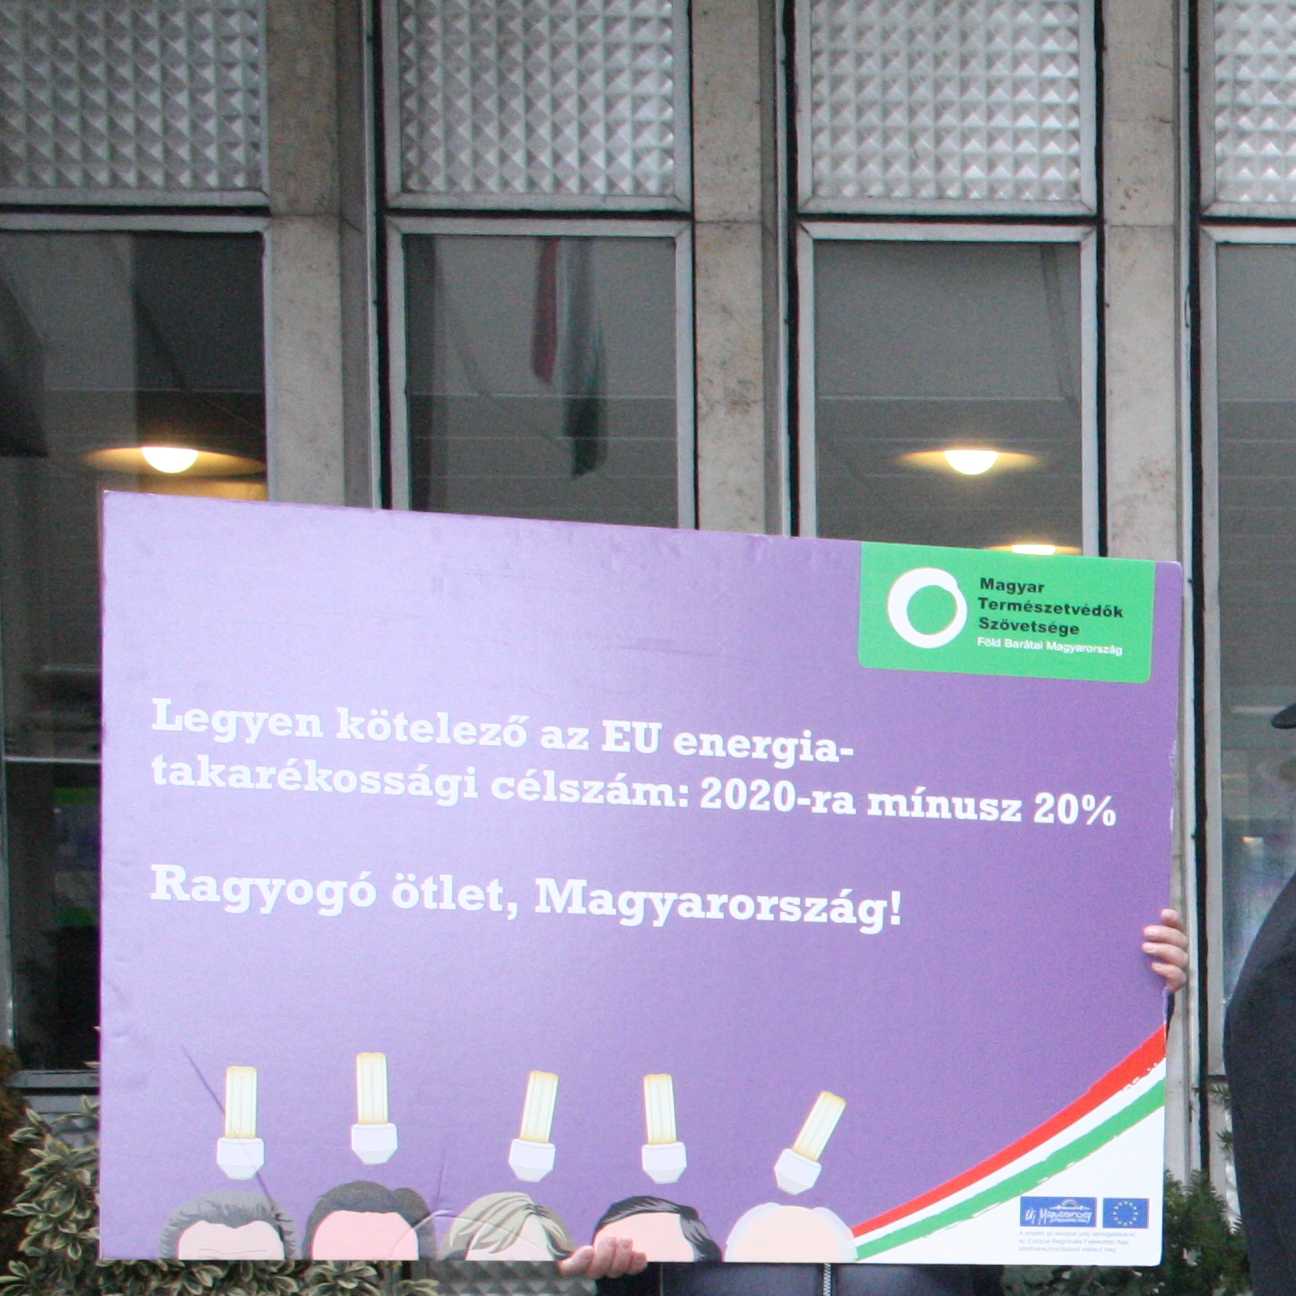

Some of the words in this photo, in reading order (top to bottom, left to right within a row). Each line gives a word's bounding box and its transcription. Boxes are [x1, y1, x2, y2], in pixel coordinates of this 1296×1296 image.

[978, 597, 1124, 618] Természetvédők
[980, 577, 1045, 595] Magyar
[979, 617, 1081, 637] Szövetsége
[151, 698, 325, 744] Legyen
[336, 707, 529, 747] kötelező
[540, 723, 590, 751] az
[602, 719, 663, 754] EU
[673, 729, 854, 769] energia-
[151, 753, 478, 807] takarékossági
[490, 768, 689, 808] célszám:
[701, 776, 857, 816] 2020-ra
[867, 786, 1022, 823] mínusz
[1033, 792, 1117, 827] 20%
[150, 864, 377, 917] Ragyogó
[391, 872, 518, 921] ötlet,
[534, 878, 902, 934] Magyarország!
